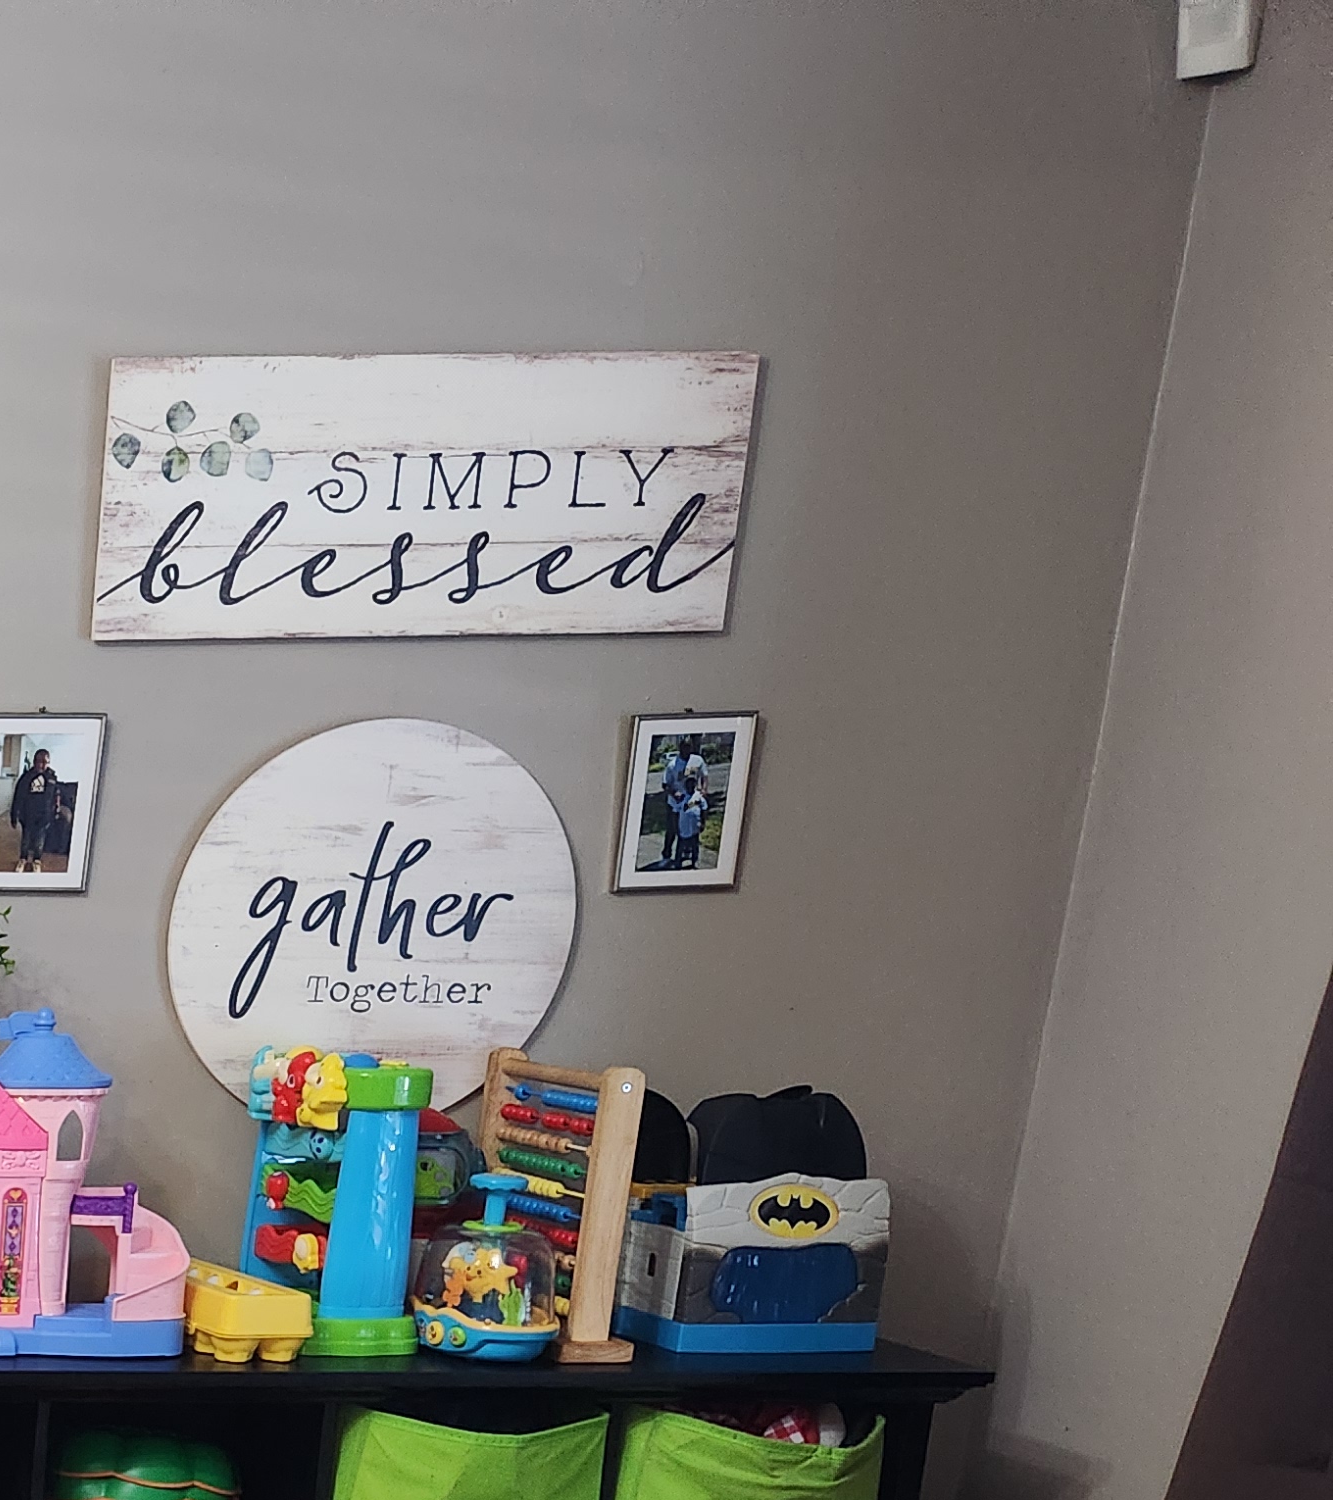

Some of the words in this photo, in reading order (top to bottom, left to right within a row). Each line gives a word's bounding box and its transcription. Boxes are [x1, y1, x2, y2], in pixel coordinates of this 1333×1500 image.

[308, 449, 674, 513] SIMPLY
[97, 493, 736, 605] blessed
[229, 821, 513, 1018] gather
[307, 974, 492, 1012] Together
